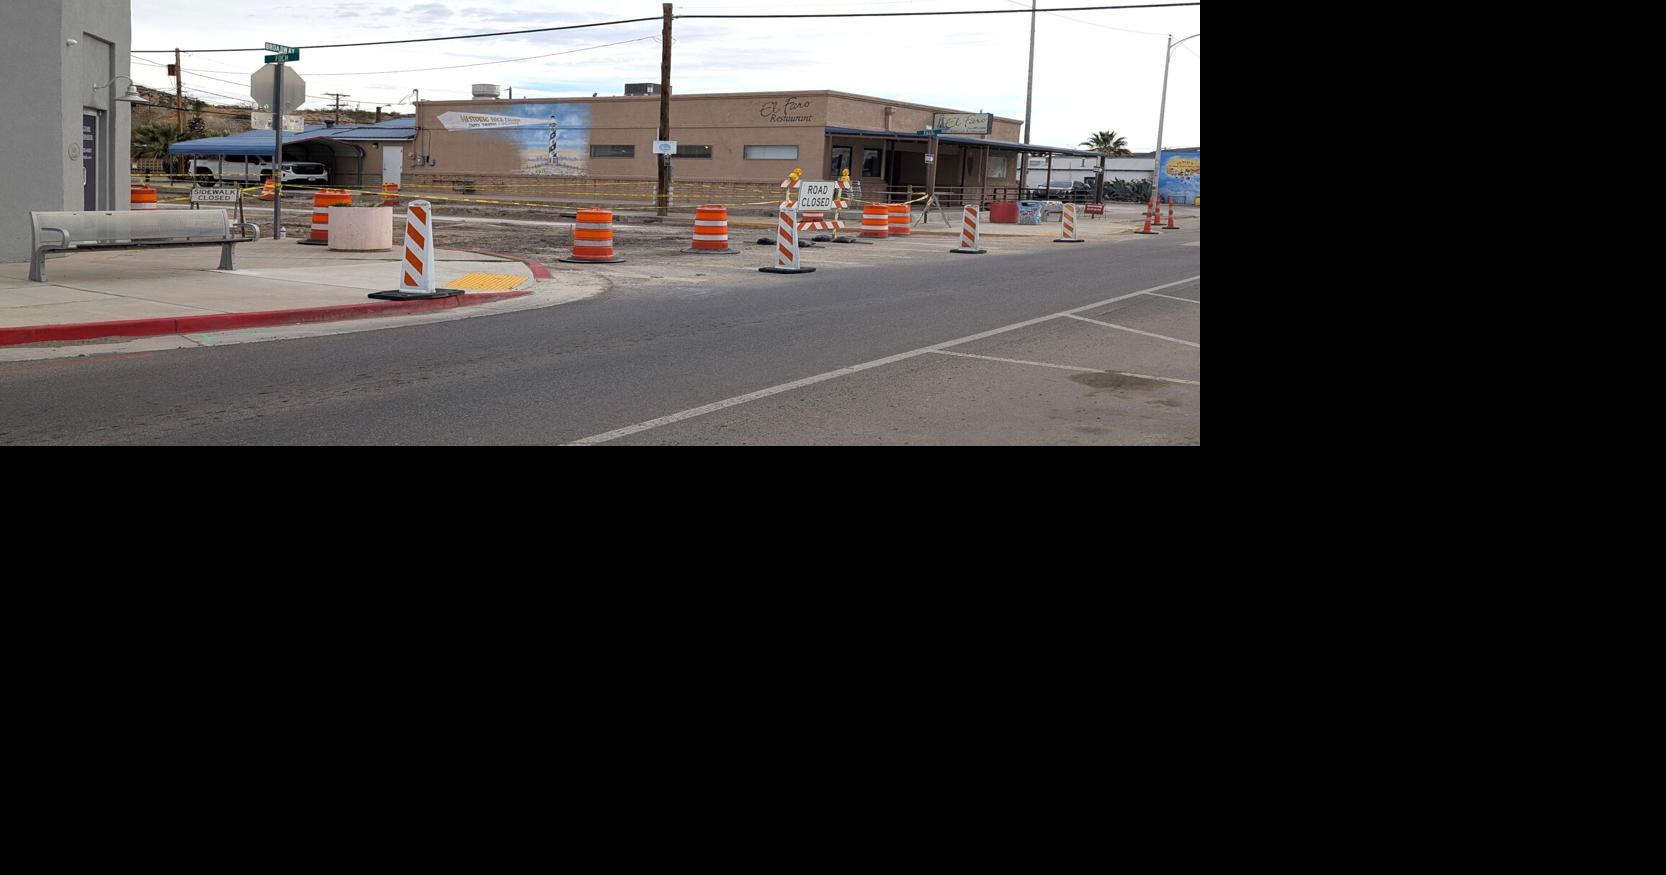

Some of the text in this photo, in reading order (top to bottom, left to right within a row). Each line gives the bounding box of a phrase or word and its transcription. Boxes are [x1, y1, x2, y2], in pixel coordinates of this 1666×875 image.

[760, 96, 810, 117] El Faro
[807, 185, 829, 195] ROAD
[801, 197, 830, 207] CLOSED
